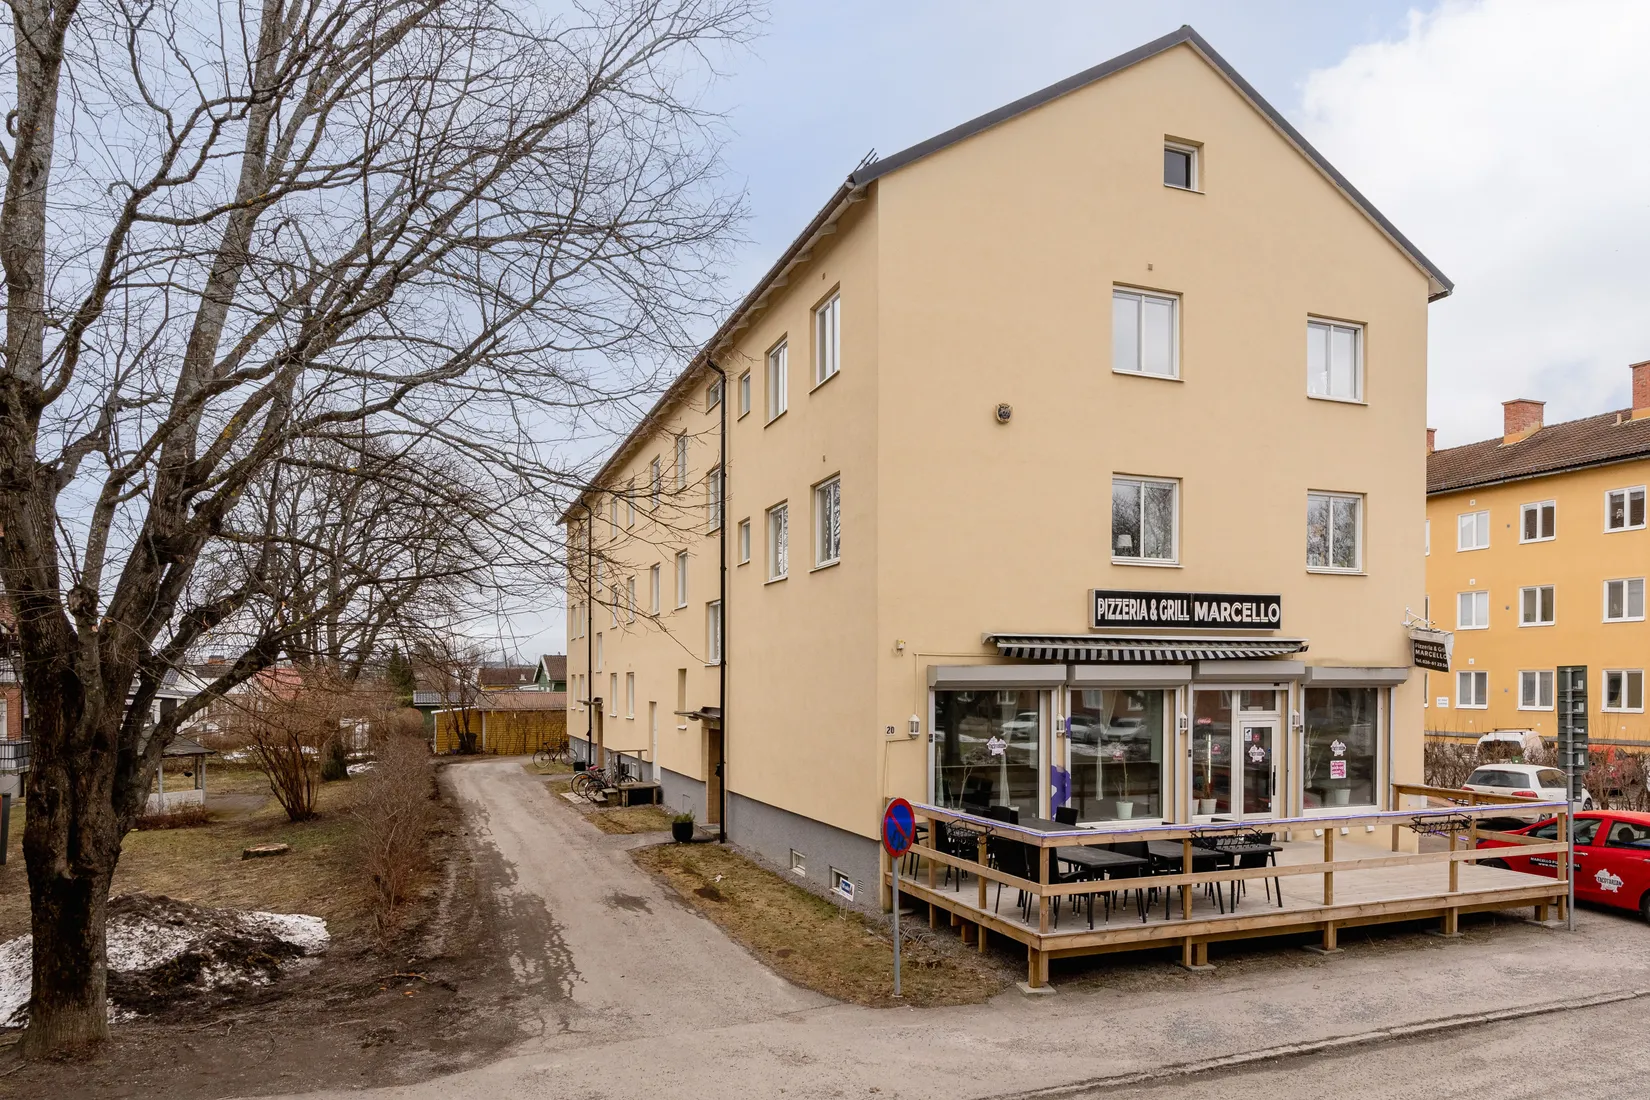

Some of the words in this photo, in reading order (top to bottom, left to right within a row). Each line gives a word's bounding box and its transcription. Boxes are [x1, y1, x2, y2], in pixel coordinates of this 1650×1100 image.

[1098, 598, 1148, 620] PIZZERIA
[1150, 598, 1158, 621] &
[1160, 600, 1190, 620] GRILL
[1194, 602, 1280, 622] MARCELLO
[1416, 649, 1447, 660] MARCELLO
[886, 726, 894, 734] 20
